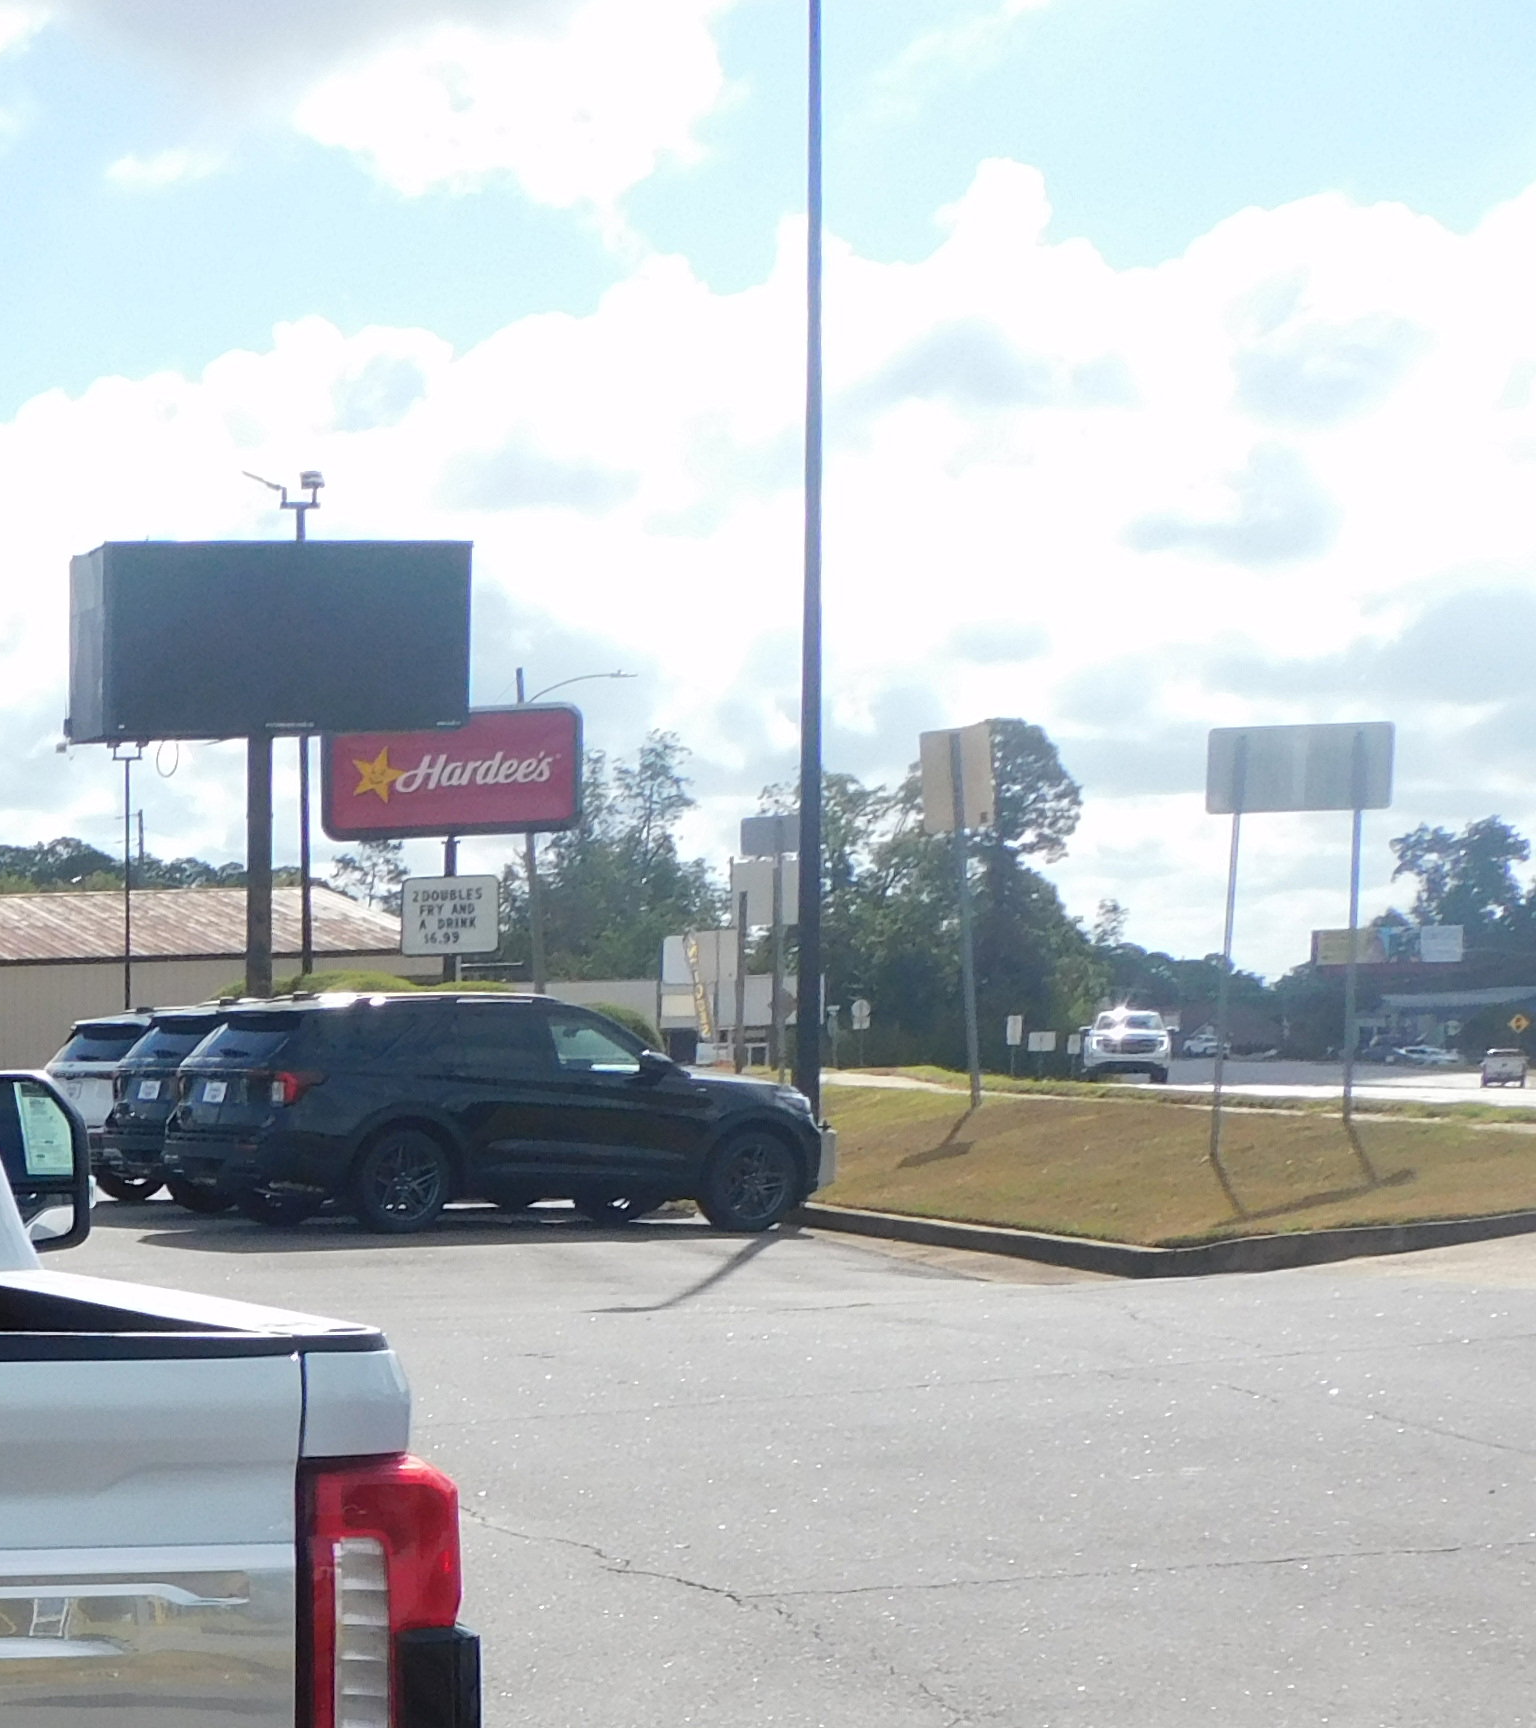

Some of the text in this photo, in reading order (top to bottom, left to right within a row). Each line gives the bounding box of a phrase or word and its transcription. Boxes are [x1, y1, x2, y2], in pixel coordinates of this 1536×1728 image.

[395, 751, 553, 793] Hardee's
[419, 902, 475, 917] FRY AND
[419, 916, 477, 931] A DRINK
